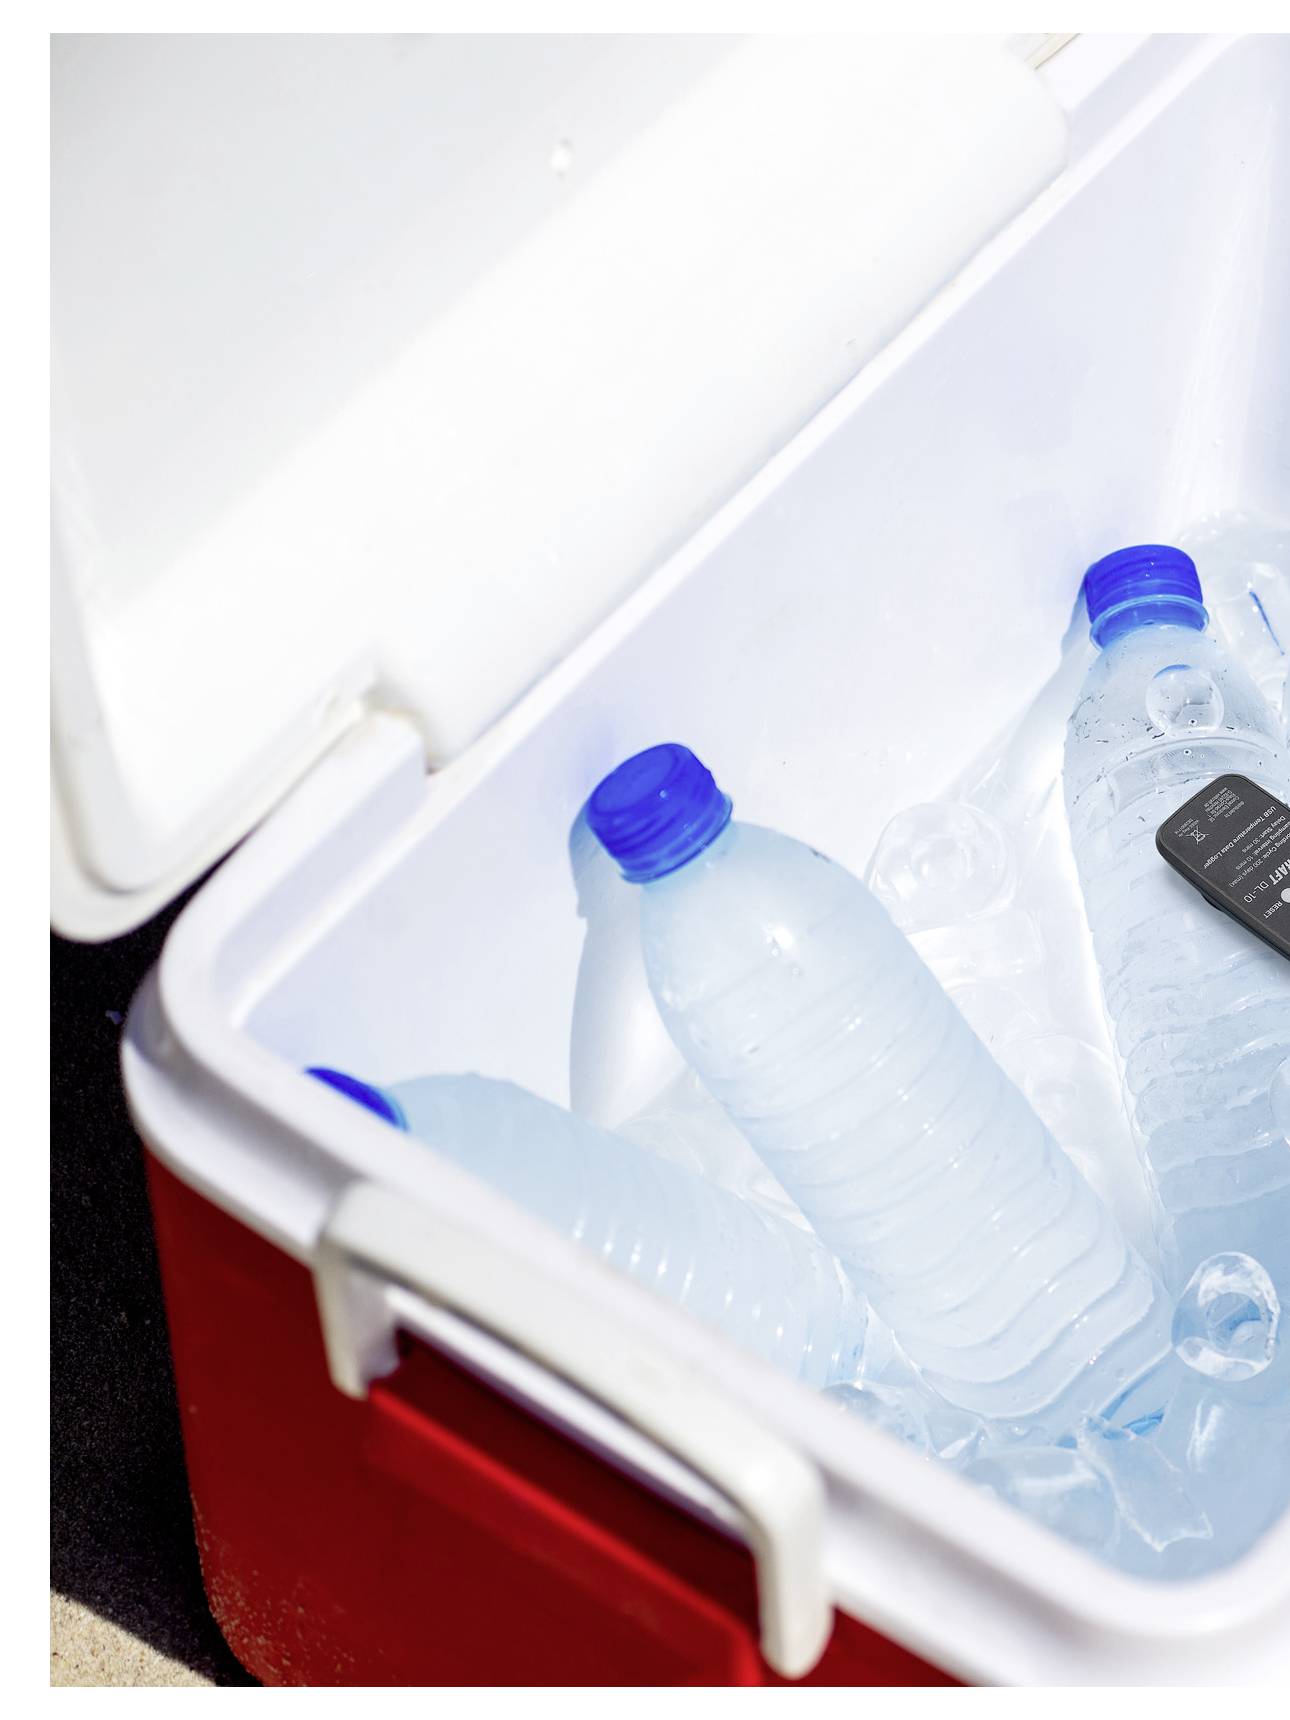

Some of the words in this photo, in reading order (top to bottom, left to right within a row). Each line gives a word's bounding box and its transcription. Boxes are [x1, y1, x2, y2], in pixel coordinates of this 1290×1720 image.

[1263, 806, 1277, 818] USB
[1232, 816, 1265, 843] Temperature
[1270, 815, 1286, 828] Delay
[1221, 842, 1235, 853] Data
[1203, 851, 1223, 869] Logger
[1243, 881, 1269, 903] DL-10
[1263, 901, 1283, 919] RESET
